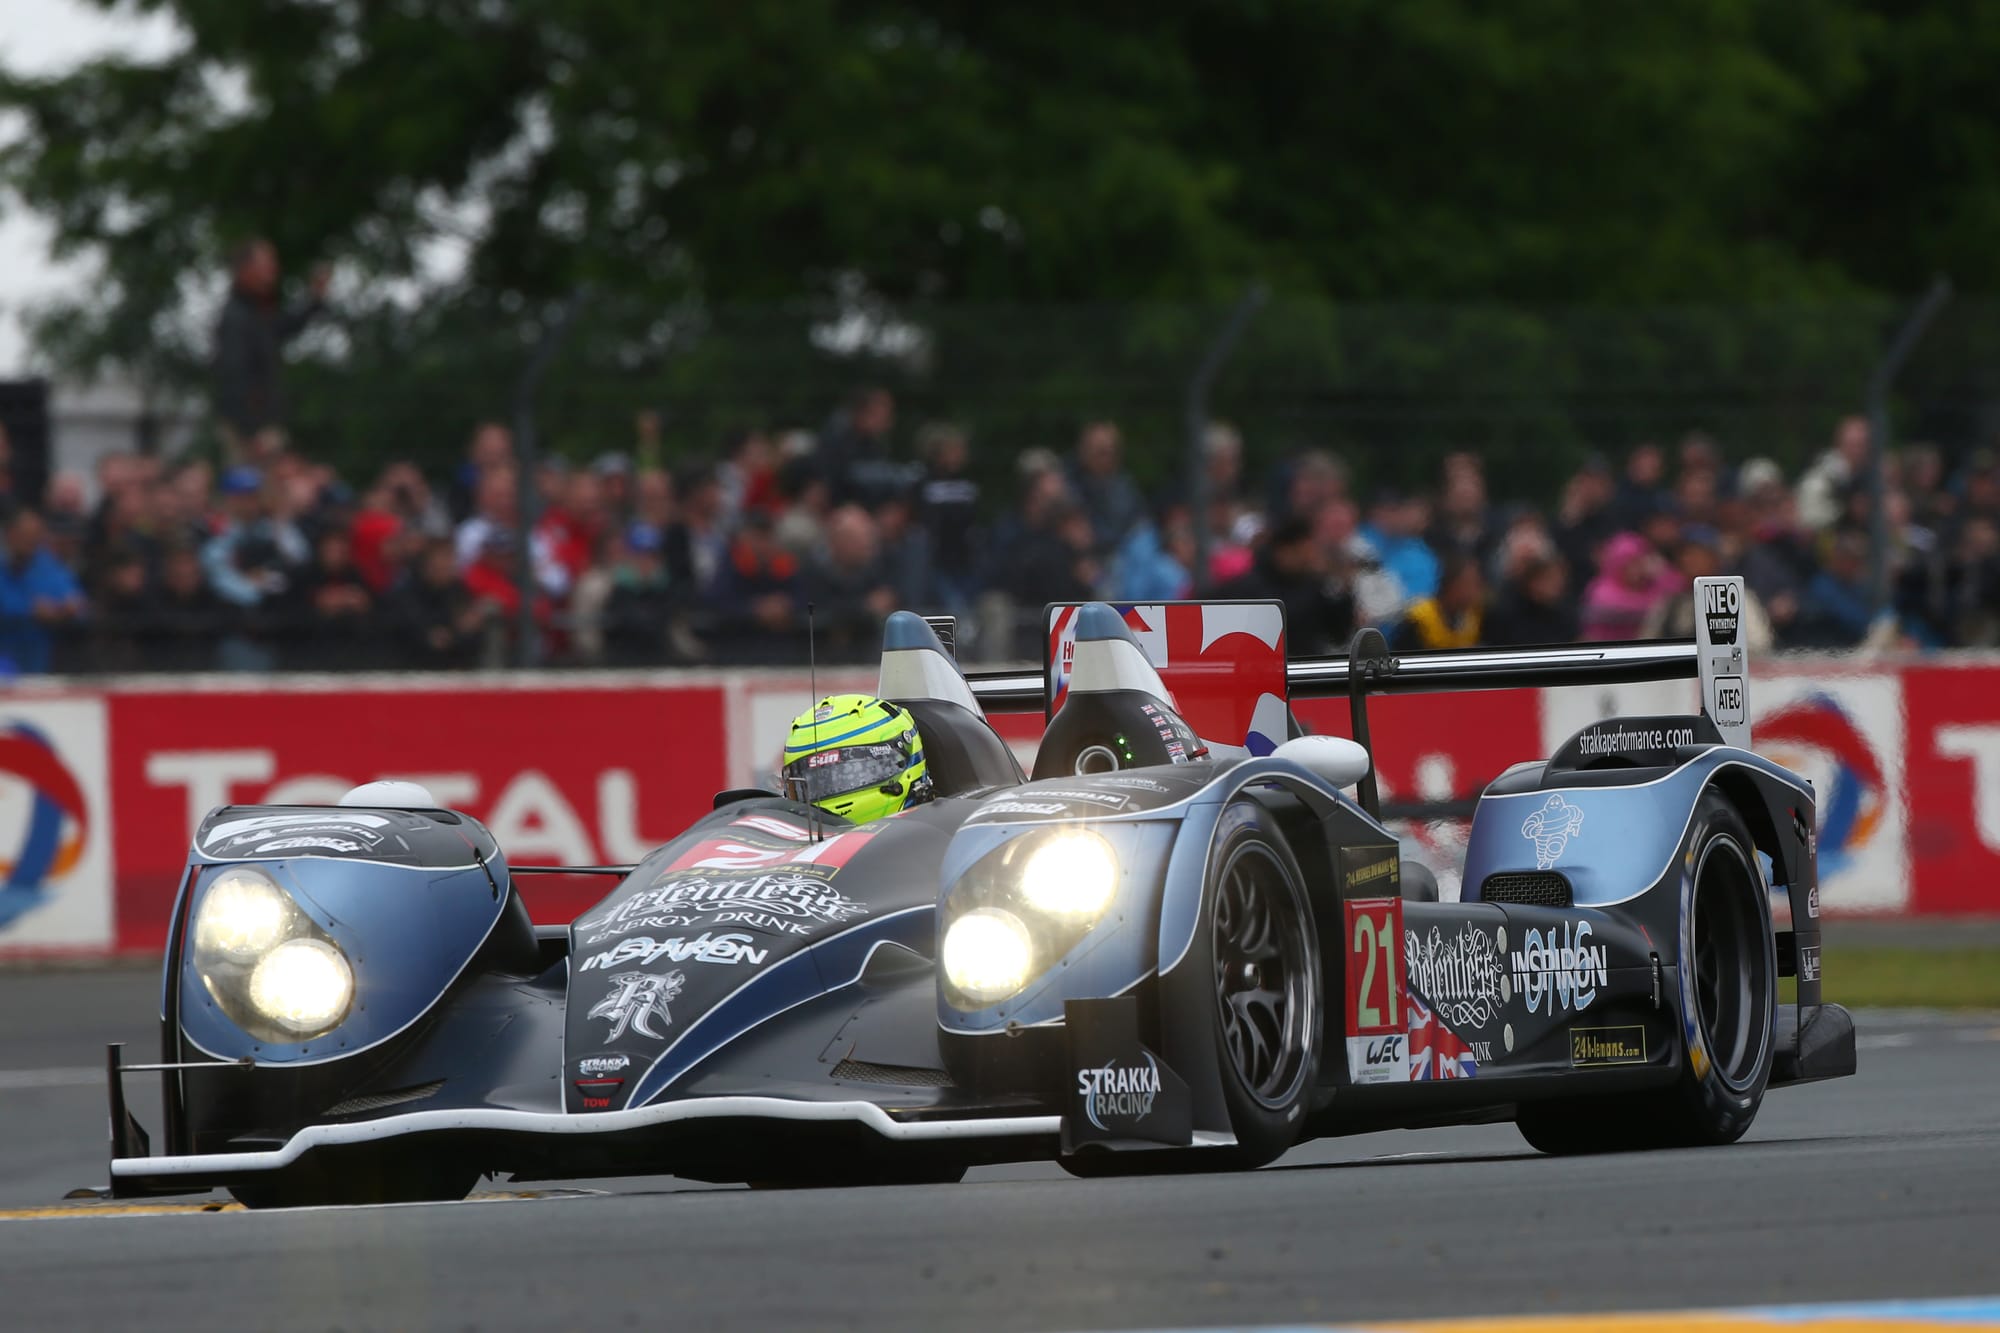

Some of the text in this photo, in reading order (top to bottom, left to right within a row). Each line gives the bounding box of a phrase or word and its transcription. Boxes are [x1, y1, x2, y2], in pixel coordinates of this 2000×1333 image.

[1704, 583, 1739, 614] NEO
[1709, 618, 1736, 630] SYNTHETICS
[1719, 689, 1741, 710] ATEC
[1580, 724, 1693, 756] strakkaperformance.com
[809, 753, 839, 767] Sun
[146, 748, 668, 866] TAL
[691, 833, 845, 871] 21
[587, 911, 813, 944] ENERGY DRINK
[1354, 911, 1398, 1028] 21
[579, 1056, 630, 1068] STRAKKA
[1366, 1036, 1403, 1064] WEC
[1078, 1067, 1161, 1095] STRAKKA
[583, 1097, 609, 1107] TOW
[1096, 1094, 1152, 1116] RACING
